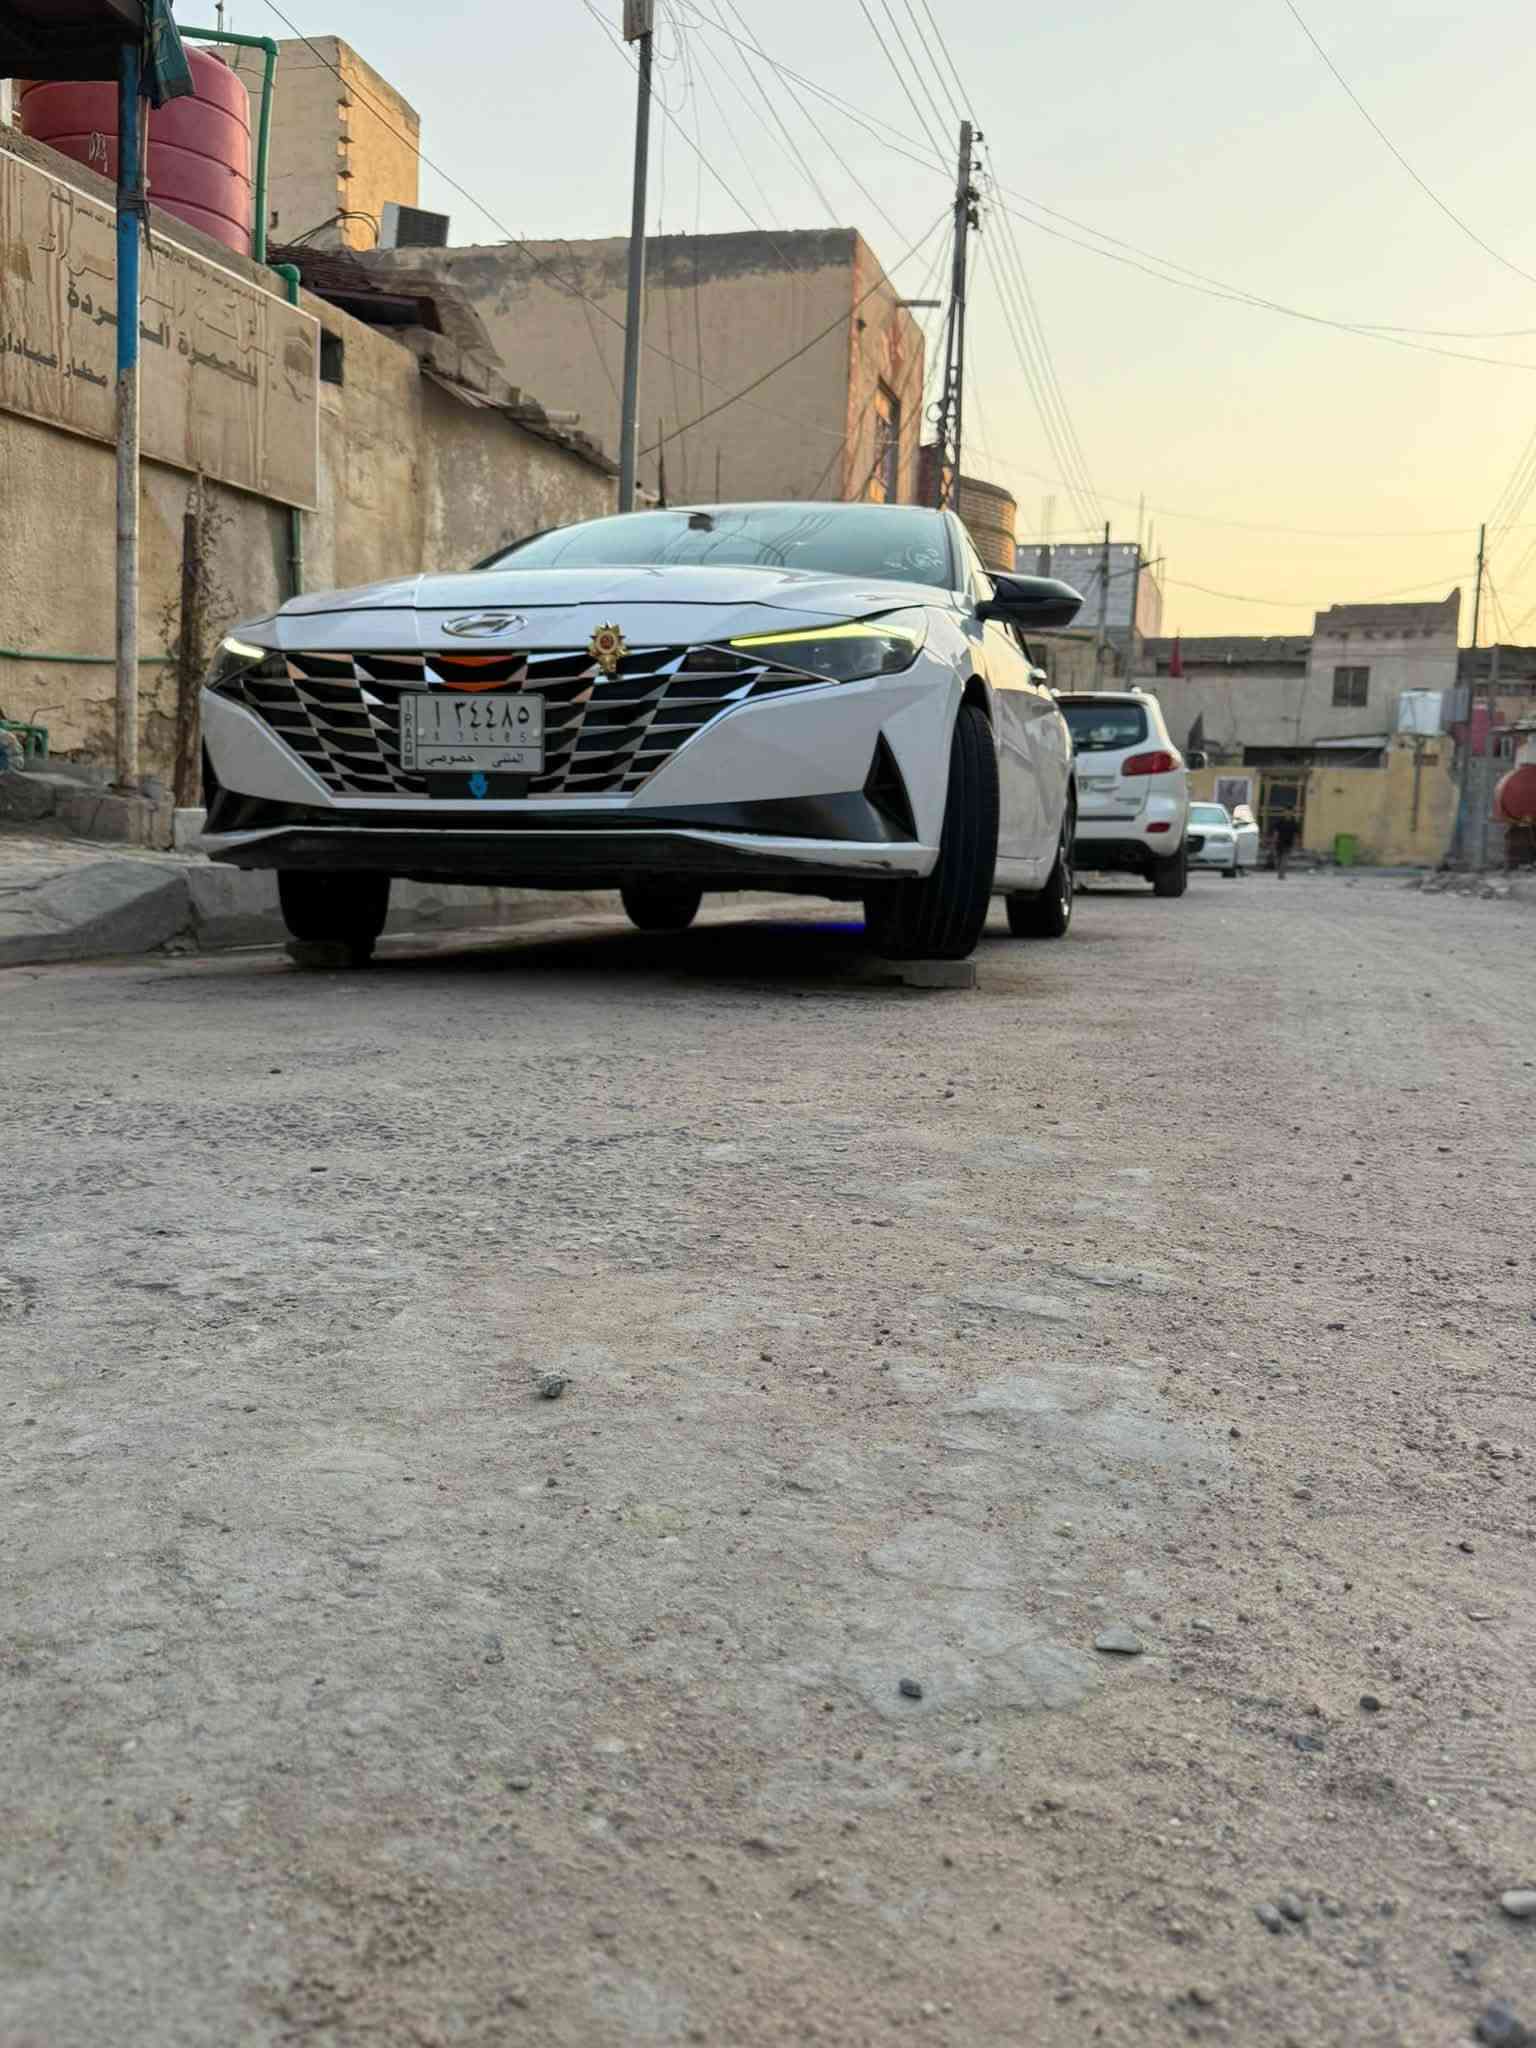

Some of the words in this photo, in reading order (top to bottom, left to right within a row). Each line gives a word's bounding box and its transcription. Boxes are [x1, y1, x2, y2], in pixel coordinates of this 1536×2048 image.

[67, 280, 170, 348] الردة
[60, 353, 108, 387] مطار
[425, 753, 476, 768] خصوصي
